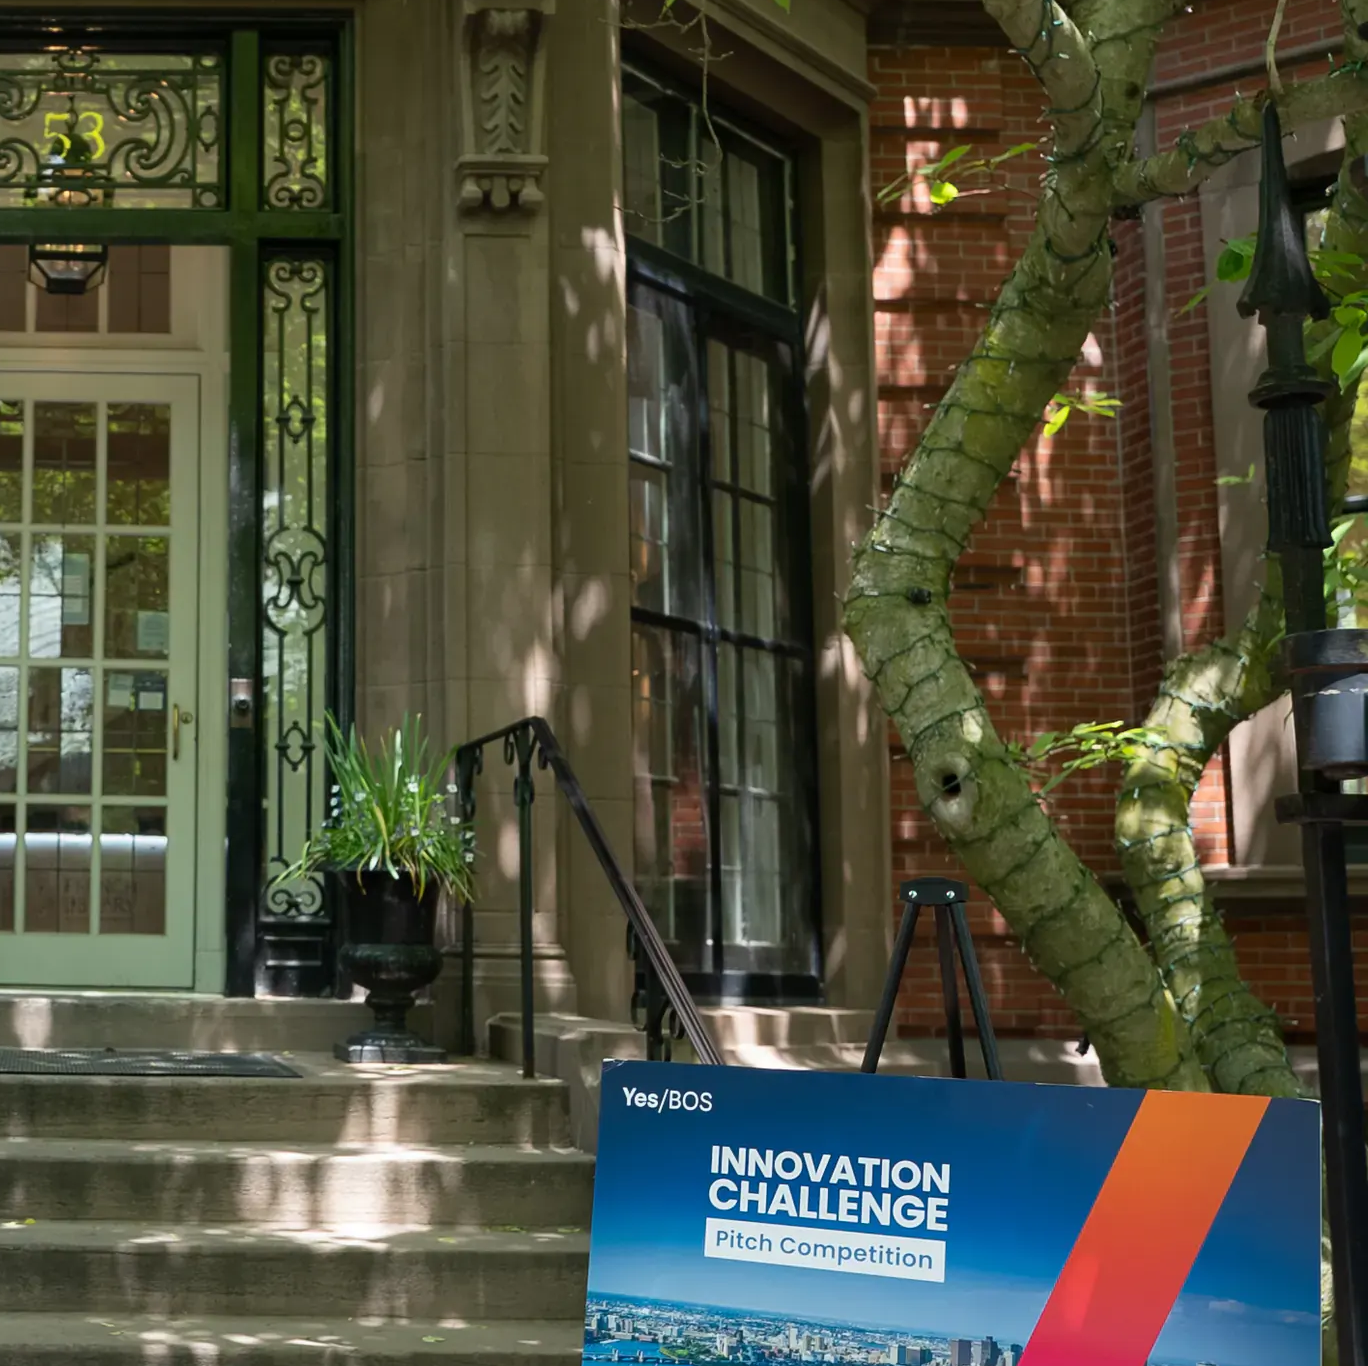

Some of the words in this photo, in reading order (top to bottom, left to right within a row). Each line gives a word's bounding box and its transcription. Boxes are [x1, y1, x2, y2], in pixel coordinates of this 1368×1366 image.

[43, 111, 106, 161] 53
[622, 1086, 713, 1114] Yes/BOS
[710, 1144, 951, 1194] INNOVATION
[708, 1178, 949, 1232] CHALLENGE
[715, 1229, 773, 1253] Pitch
[779, 1237, 934, 1270] Competition
